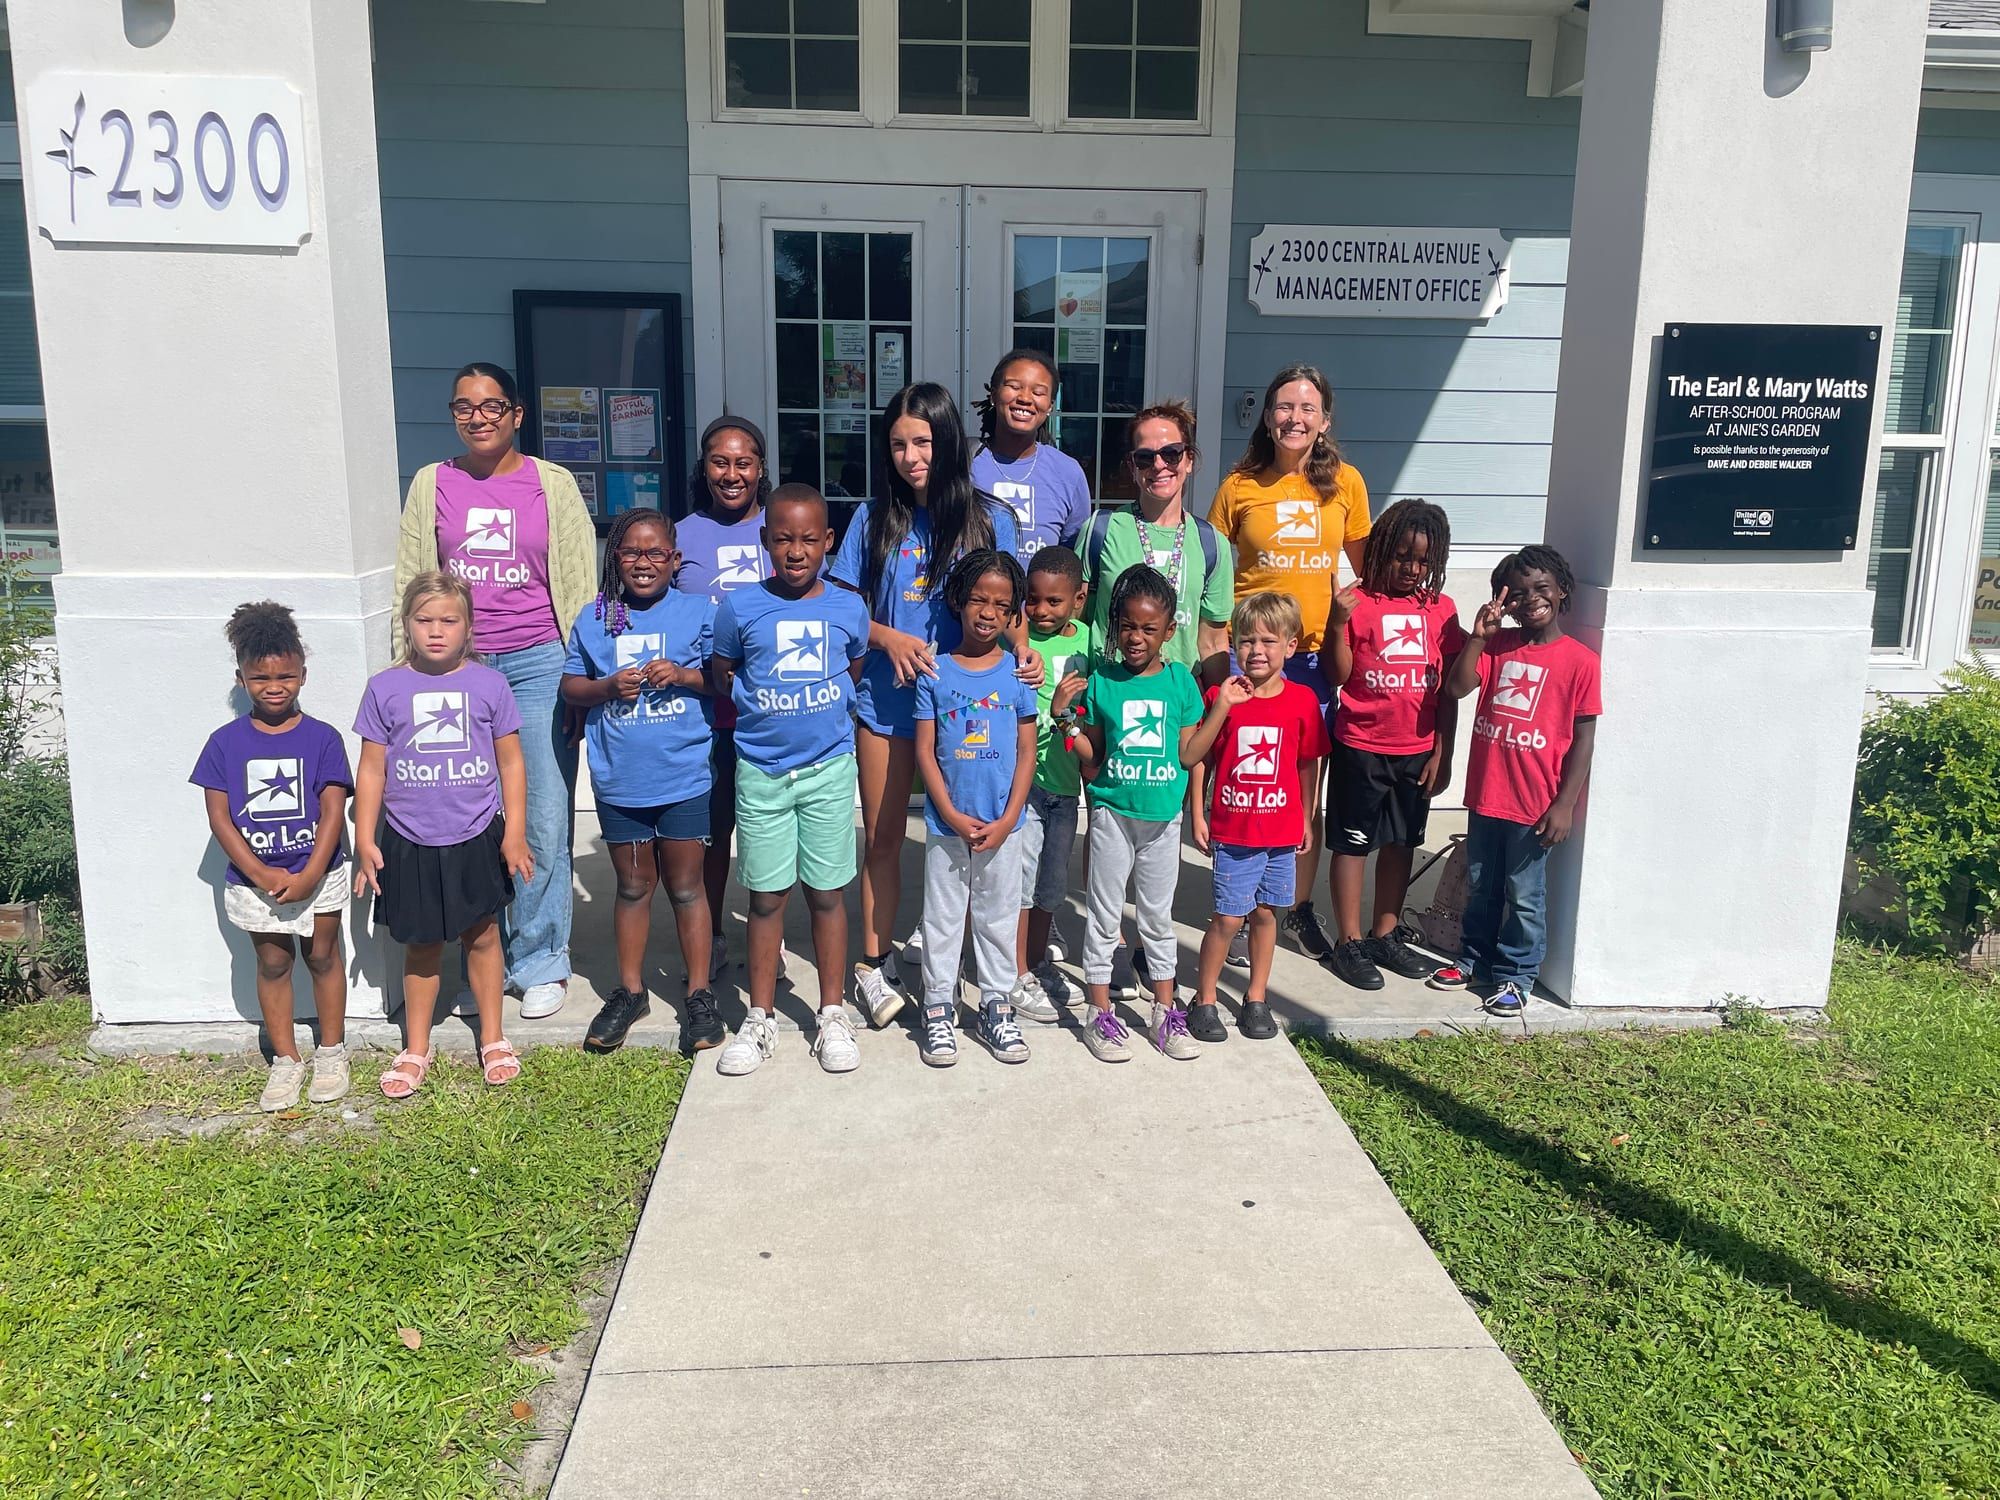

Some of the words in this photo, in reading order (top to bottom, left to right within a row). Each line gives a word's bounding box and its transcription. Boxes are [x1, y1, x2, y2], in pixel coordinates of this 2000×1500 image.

[100, 109, 290, 213] 2300
[1281, 240, 1329, 262] 2300
[1332, 241, 1410, 263] CENTRAL
[1413, 242, 1480, 265] AVENUE
[1276, 276, 1412, 301] MANAGEMENT
[1415, 279, 1481, 302] OFFICE
[1668, 375, 1702, 397] The
[1706, 376, 1742, 398] Earl
[1746, 377, 1760, 398] &
[1765, 377, 1812, 403] Mary
[1816, 378, 1868, 399] Watts
[612, 399, 646, 412] JOYFUL
[1689, 405, 1779, 419] AFTER-SCHOOL
[1781, 406, 1841, 420] PROGRAM
[1706, 423, 1722, 436] AT
[1724, 423, 1769, 437] JANIE'S
[1771, 423, 1820, 437] GARDEN
[1693, 444, 1701, 454] is
[1702, 444, 1732, 456] possible
[1733, 445, 1758, 454] thanks
[1760, 446, 1768, 454] to
[1769, 445, 1781, 455] the
[1782, 446, 1819, 456] generosity
[1820, 445, 1830, 455] of
[1707, 460, 1728, 468] DAVE
[1730, 460, 1747, 468] AND
[1748, 460, 1778, 469] DEBBIE
[1779, 460, 1812, 470] WALKER
[449, 558, 489, 580] Star
[494, 562, 530, 582] Lab
[1257, 550, 1296, 568] Star
[1300, 550, 1332, 568] Lab
[1174, 608, 1192, 626] ab
[1365, 670, 1406, 688] Star
[1411, 668, 1438, 688] Lab
[602, 700, 640, 718] Star
[645, 694, 686, 718] Lab
[756, 688, 800, 710] Star
[805, 680, 840, 707] Lab
[1474, 716, 1502, 738] Star
[1506, 722, 1547, 750] Lab
[955, 749, 976, 760] Star
[980, 750, 1000, 759] Lab
[396, 760, 442, 781] Star
[448, 756, 489, 779] Lab
[1108, 758, 1142, 780] Star
[1146, 760, 1177, 780] Lab
[1222, 785, 1254, 807] Star
[1257, 787, 1287, 808] Lab
[242, 827, 276, 848] tar
